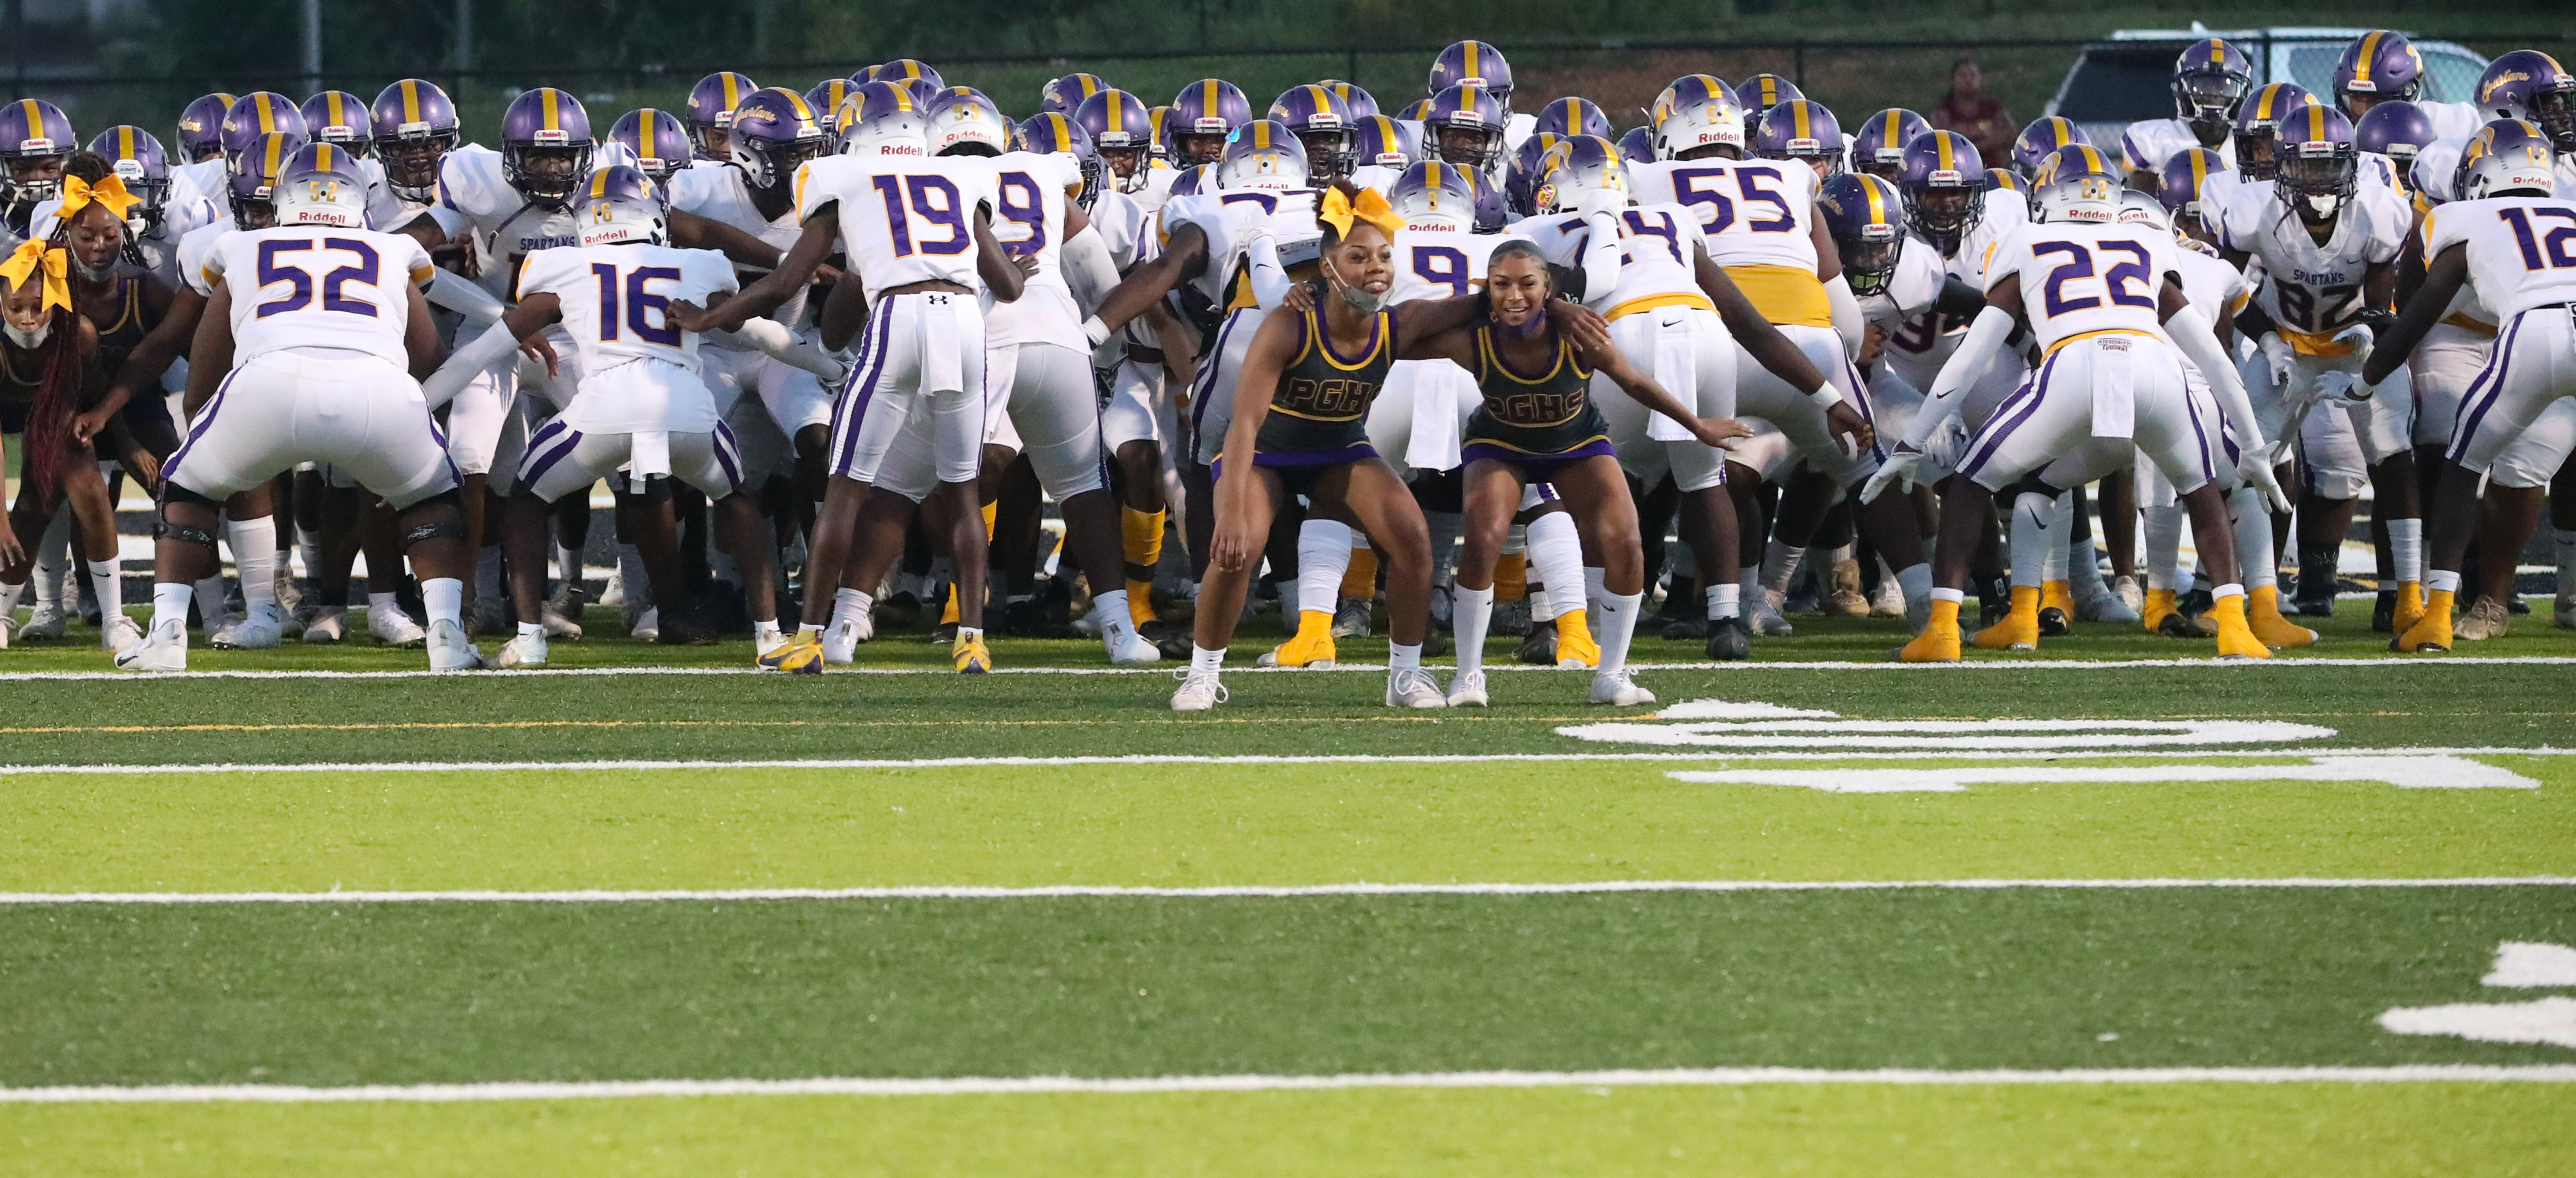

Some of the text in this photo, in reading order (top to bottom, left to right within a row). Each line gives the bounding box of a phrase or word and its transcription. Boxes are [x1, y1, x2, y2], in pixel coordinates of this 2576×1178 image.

[2482, 68, 2530, 104] Spartans
[952, 102, 980, 121] 99
[1707, 104, 1732, 124] 55
[946, 130, 992, 143] Riddell
[1699, 131, 1740, 144] Riddell
[881, 145, 923, 156] Riddell
[2527, 146, 2548, 167] 12
[1253, 154, 1279, 174] 77
[1601, 169, 1623, 191] 24
[2081, 178, 2108, 200] 22
[2513, 176, 2552, 190] Riddell
[310, 181, 338, 203] 52
[1427, 191, 1438, 210] 9
[1670, 166, 1798, 236] 55
[299, 212, 346, 224] Riddell
[591, 202, 613, 225] 16
[870, 172, 972, 259] 19
[996, 170, 1048, 257] 9
[2069, 209, 2113, 222] Riddell
[2117, 212, 2149, 224] ddell
[584, 229, 628, 246] Riddell
[1409, 223, 1456, 232] Riddell
[520, 236, 576, 251] SPARTANS
[2496, 207, 2576, 273] 12
[255, 236, 382, 322] 52
[1410, 246, 1471, 301] 9
[2030, 239, 2158, 321] 22
[2294, 269, 2345, 286] SPARTANS
[590, 262, 684, 350] 16
[2278, 279, 2362, 334] 82
[2097, 339, 2132, 347] MISSISSIPPI
[1483, 386, 1585, 422] PGHS
